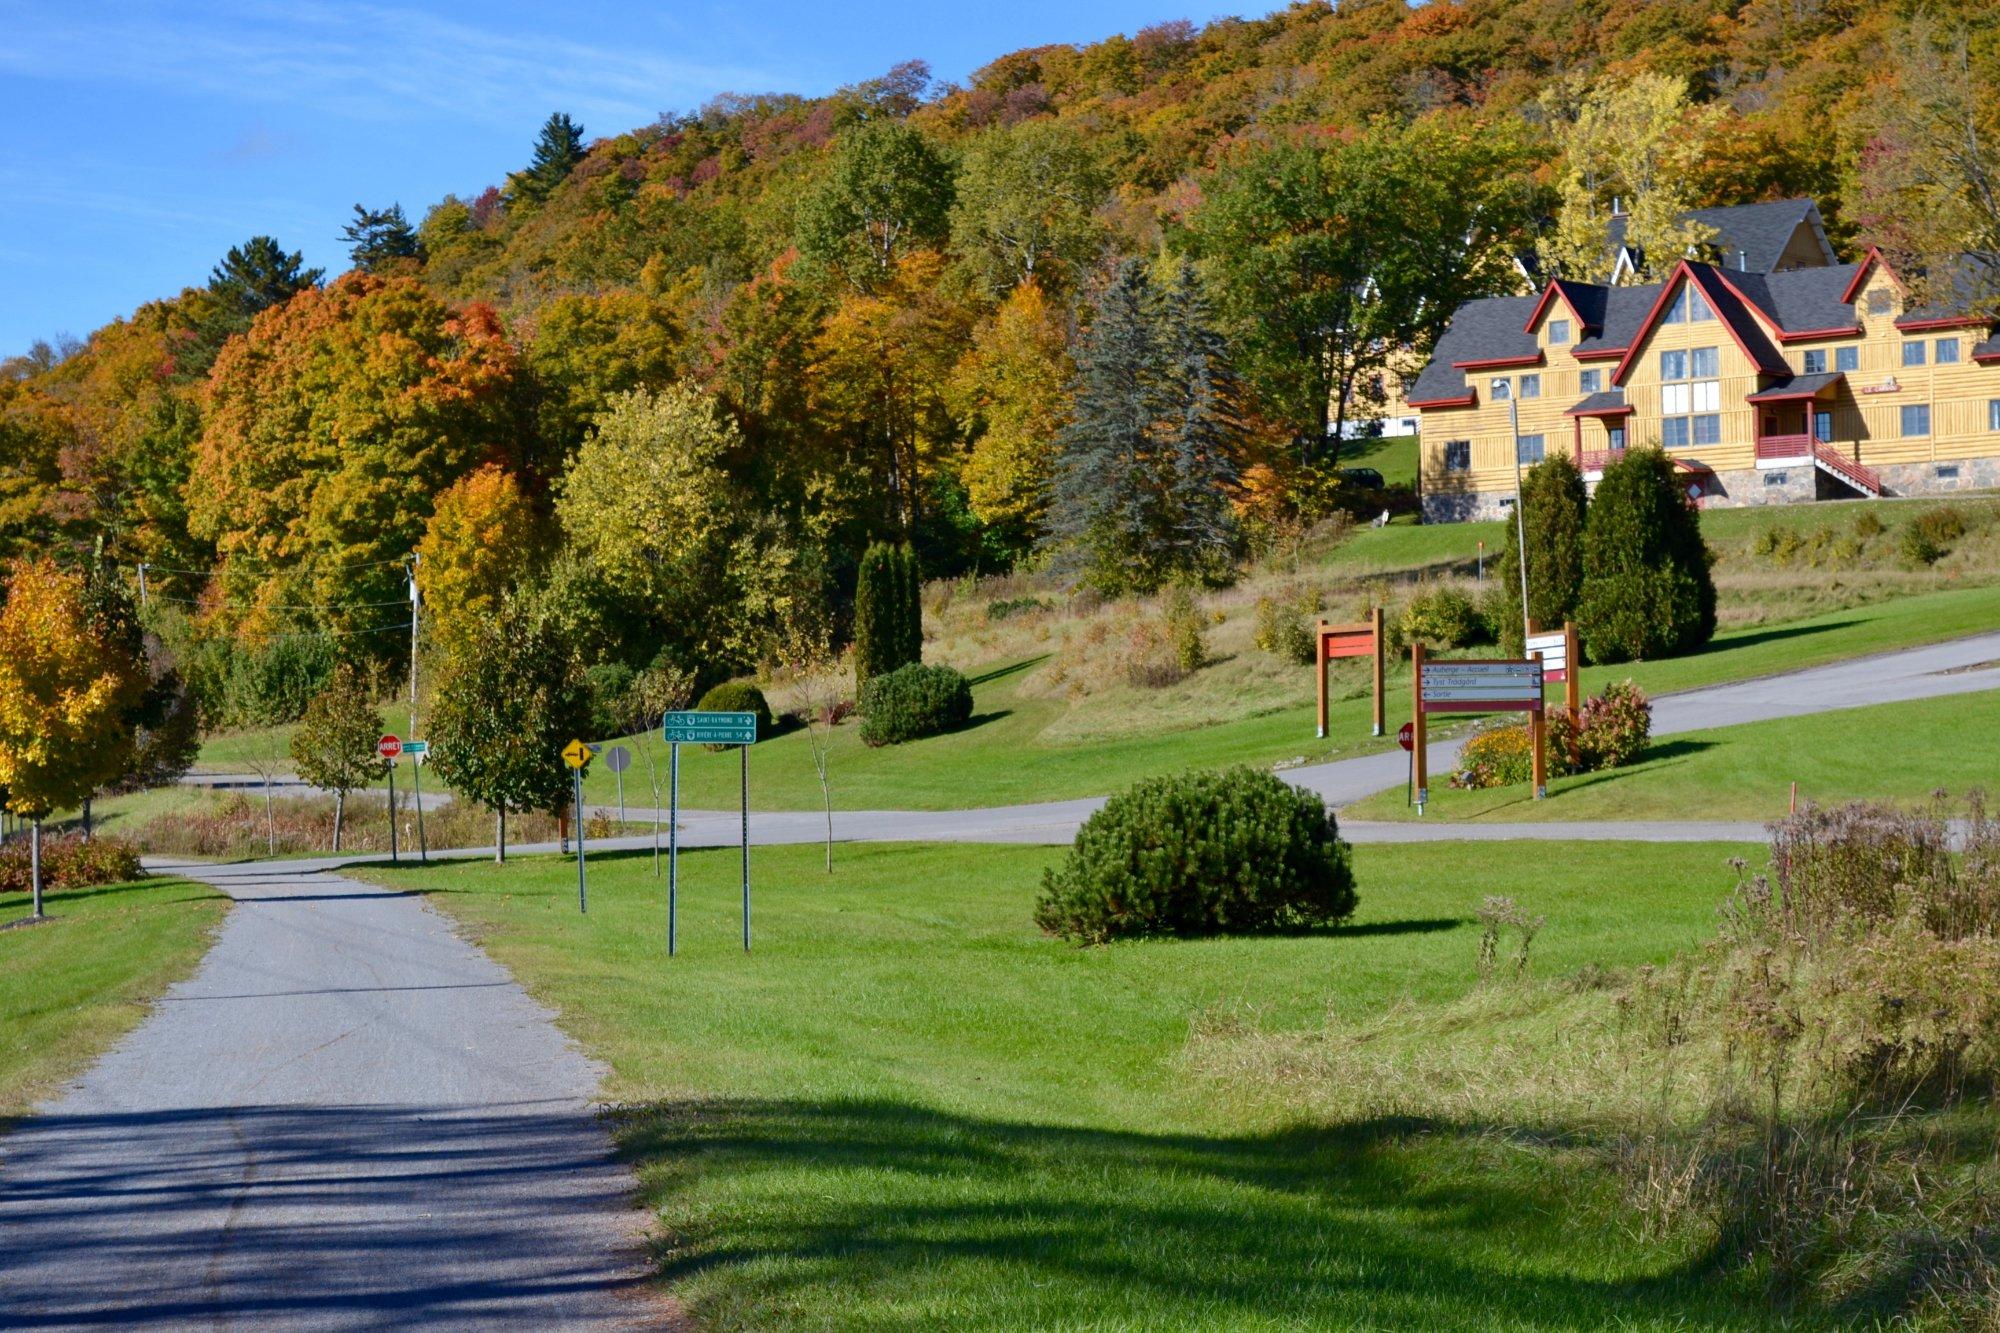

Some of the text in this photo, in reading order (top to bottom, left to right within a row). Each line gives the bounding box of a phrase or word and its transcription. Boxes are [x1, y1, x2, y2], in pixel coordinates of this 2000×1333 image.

[1433, 666, 1459, 674] Auberge
[1467, 665, 1490, 673] Accueil
[696, 716, 733, 724] SAINT-RAYMOND
